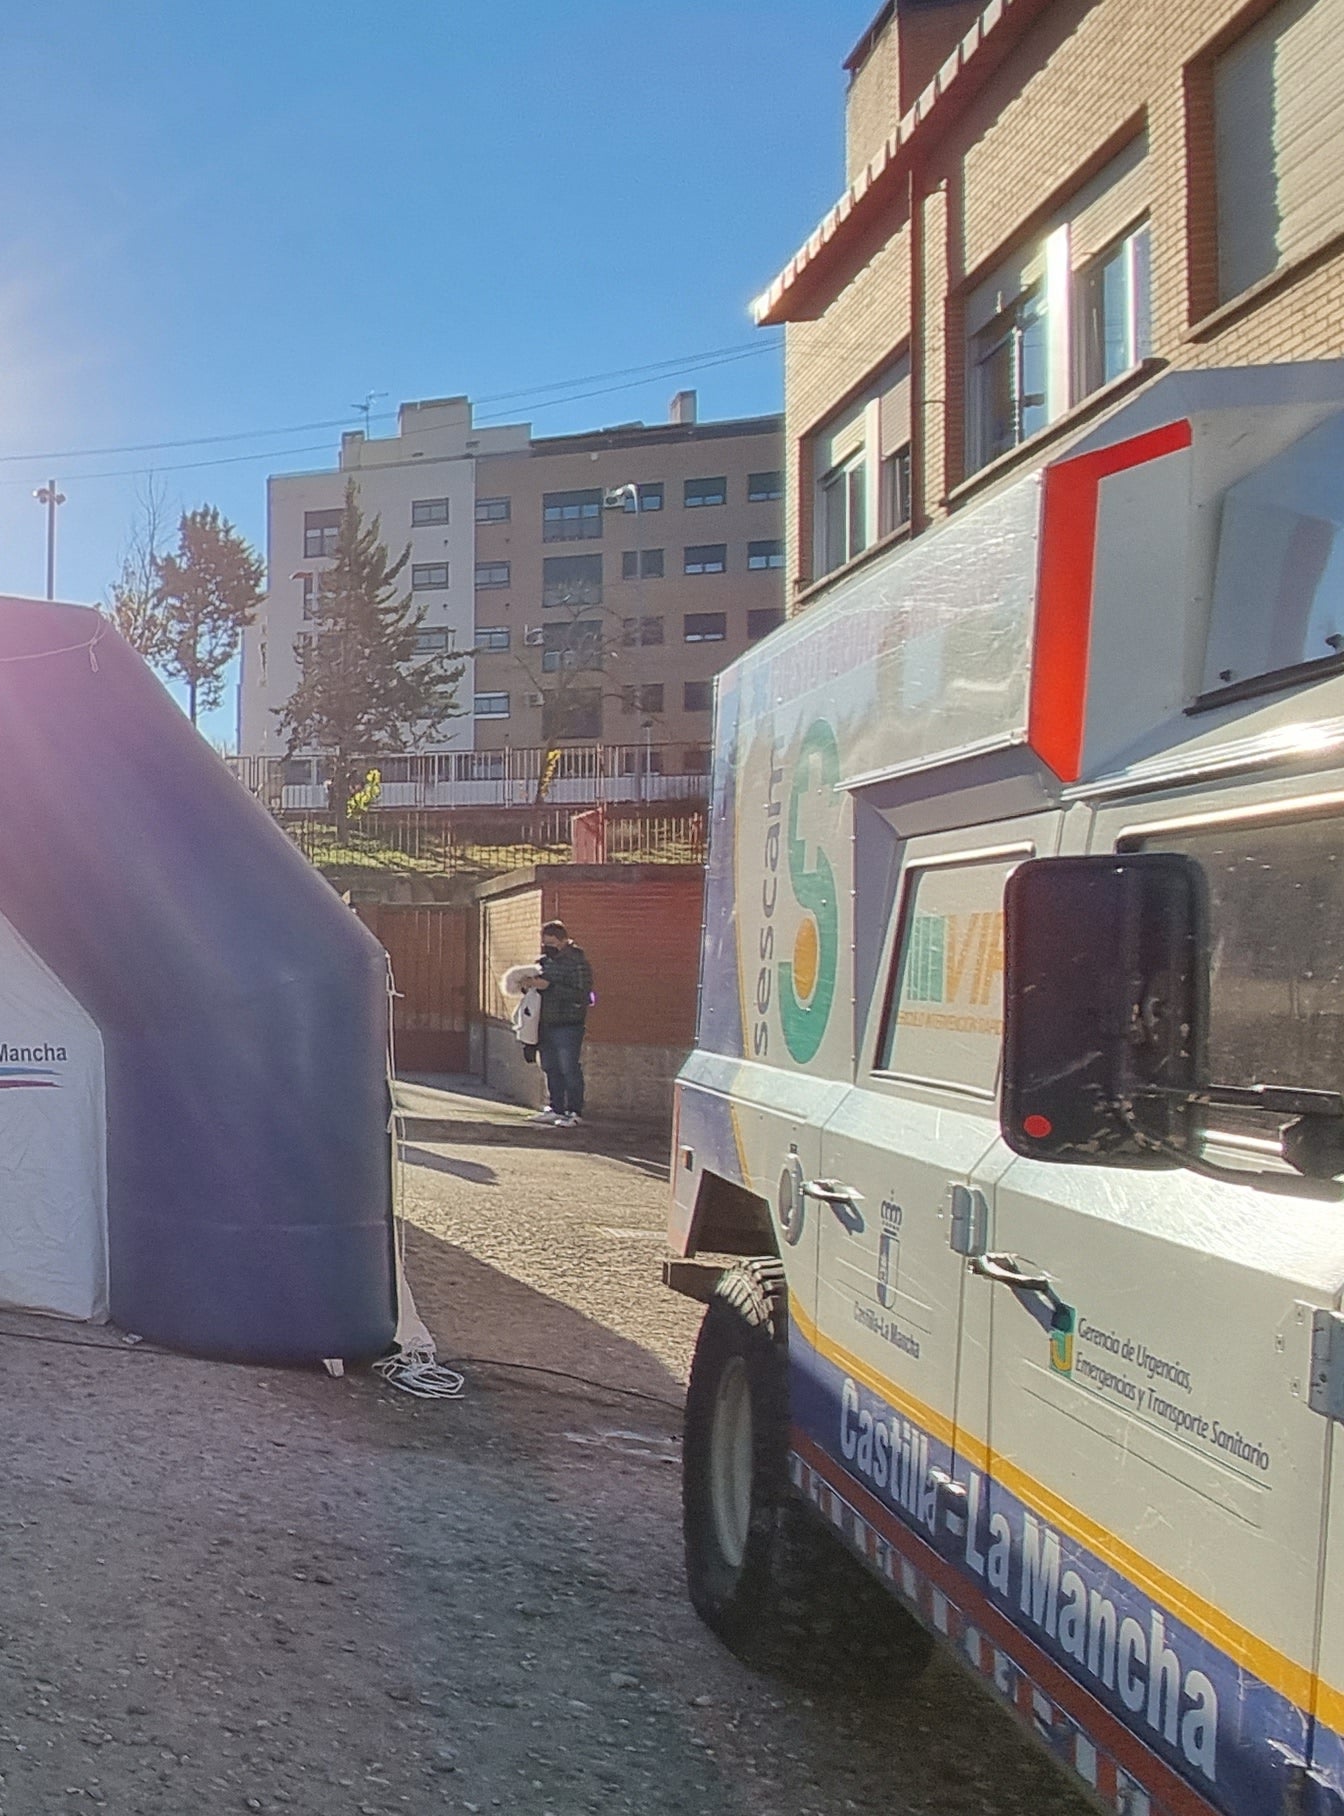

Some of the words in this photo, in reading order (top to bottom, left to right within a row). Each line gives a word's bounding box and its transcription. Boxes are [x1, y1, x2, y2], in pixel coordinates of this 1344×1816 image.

[1075, 1351, 1137, 1402] Emergencias
[1136, 1387, 1145, 1410] y
[1146, 1387, 1209, 1440] Transporte
[1210, 1420, 1269, 1471] Sanitario
[1078, 1317, 1120, 1355] Gerencia
[1121, 1337, 1134, 1362] de
[1136, 1344, 1193, 1394] Urgencias,
[1020, 1511, 1218, 1782] Mancha
